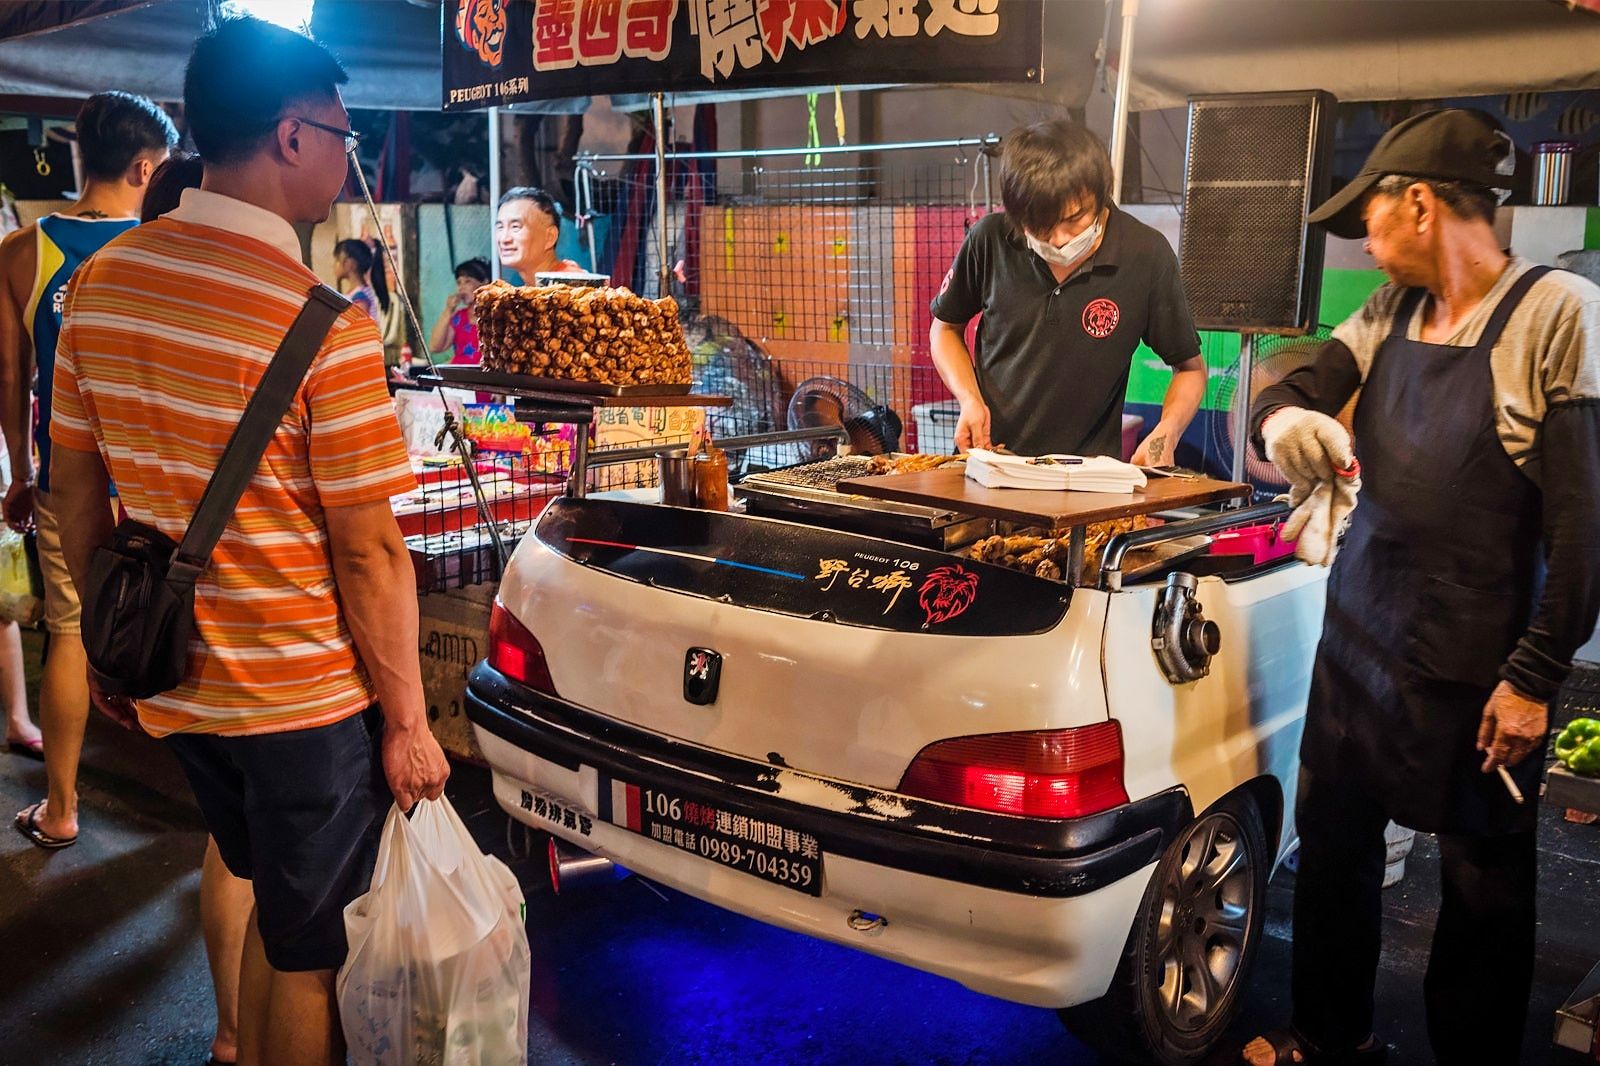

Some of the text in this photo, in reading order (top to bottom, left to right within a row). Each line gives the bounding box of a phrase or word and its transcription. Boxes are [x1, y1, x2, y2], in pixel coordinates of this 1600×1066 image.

[449, 84, 492, 103] PEUGEOT
[854, 552, 920, 571] PEUGEOT 106
[650, 821, 813, 887] 加盟電話 0989-704359
